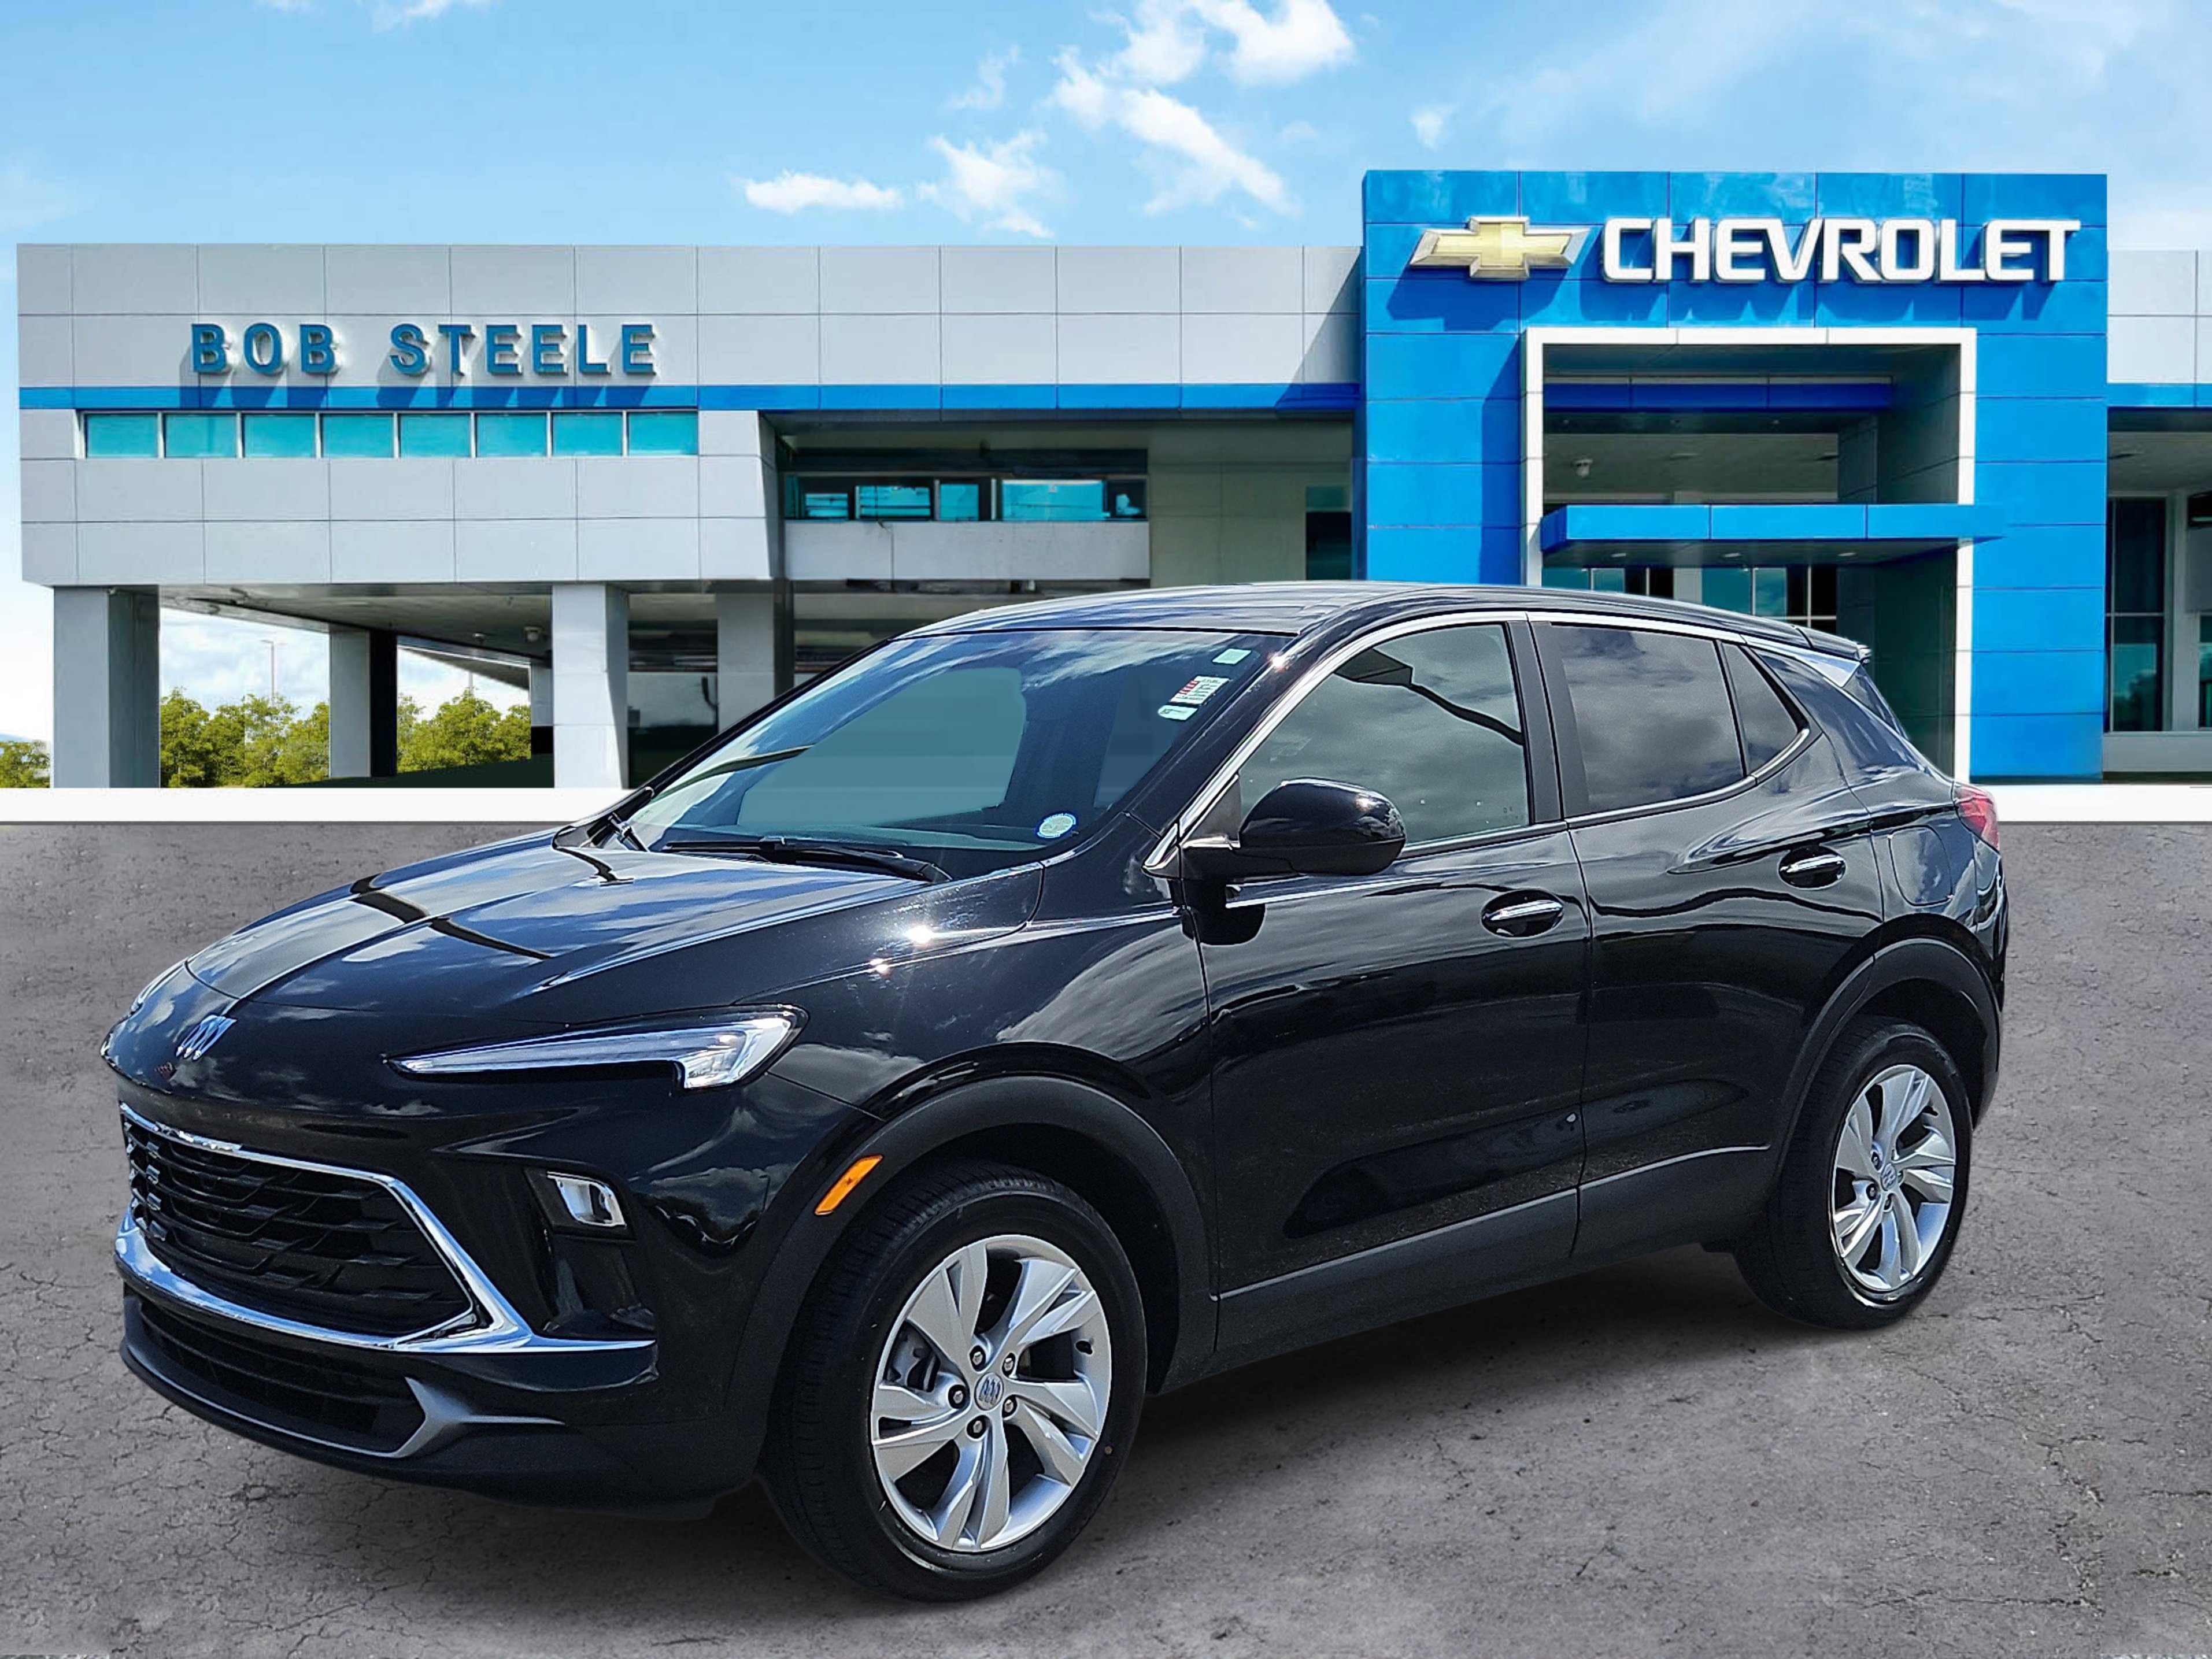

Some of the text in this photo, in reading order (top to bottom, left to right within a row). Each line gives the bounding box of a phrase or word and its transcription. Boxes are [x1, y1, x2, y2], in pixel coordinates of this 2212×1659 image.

[1602, 218, 2080, 282] CHEVROLET
[191, 323, 657, 376] BOB STEELE
